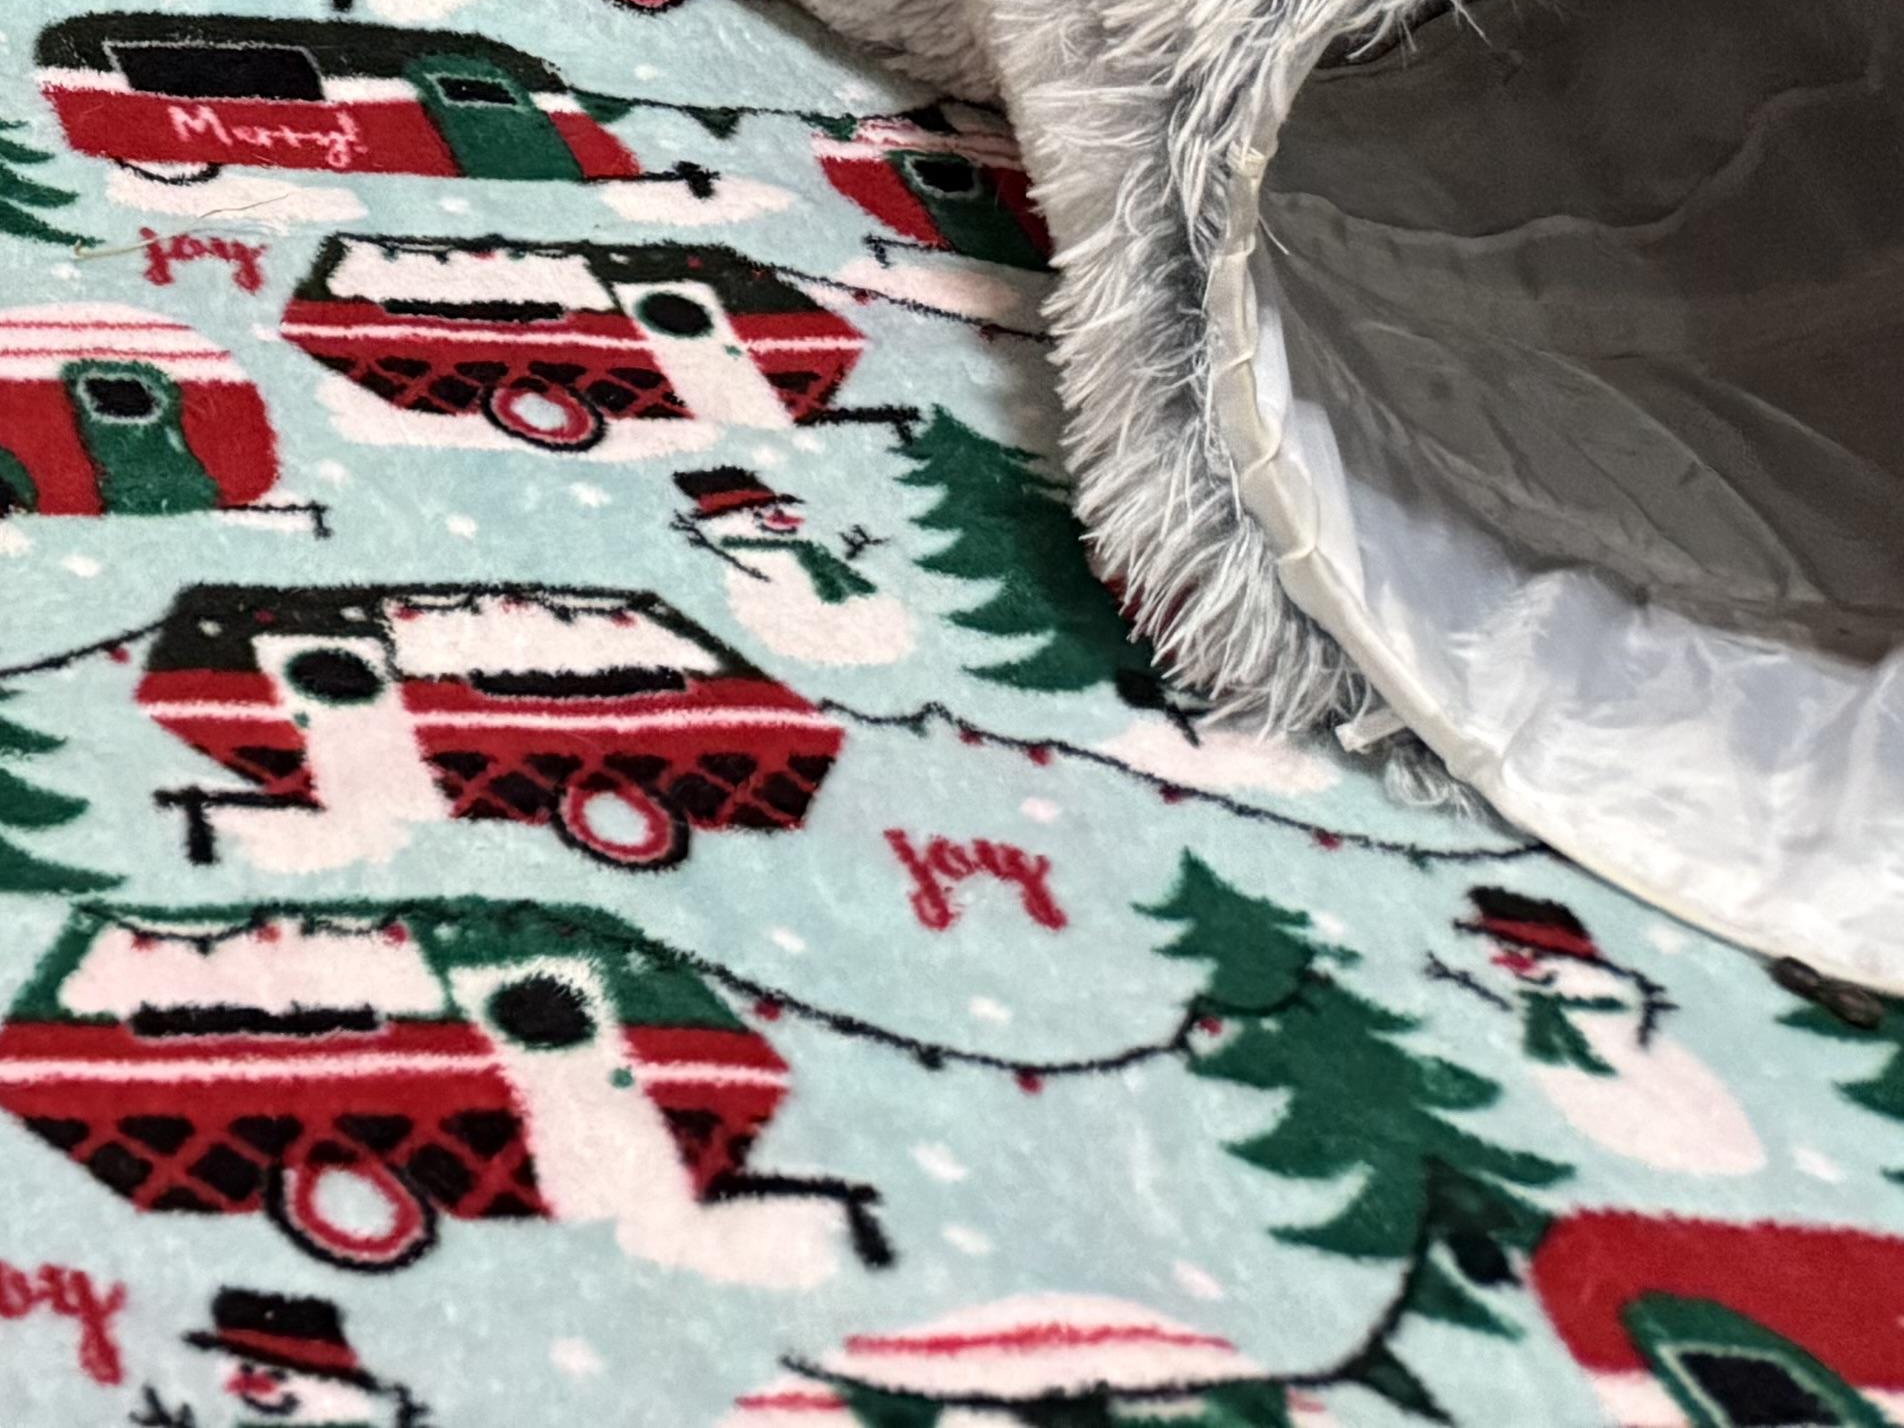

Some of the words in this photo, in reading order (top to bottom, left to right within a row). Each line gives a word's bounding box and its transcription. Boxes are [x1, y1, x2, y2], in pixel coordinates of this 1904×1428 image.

[166, 103, 370, 169] Merry!
[142, 227, 269, 293] joy
[884, 828, 1067, 931] joy
